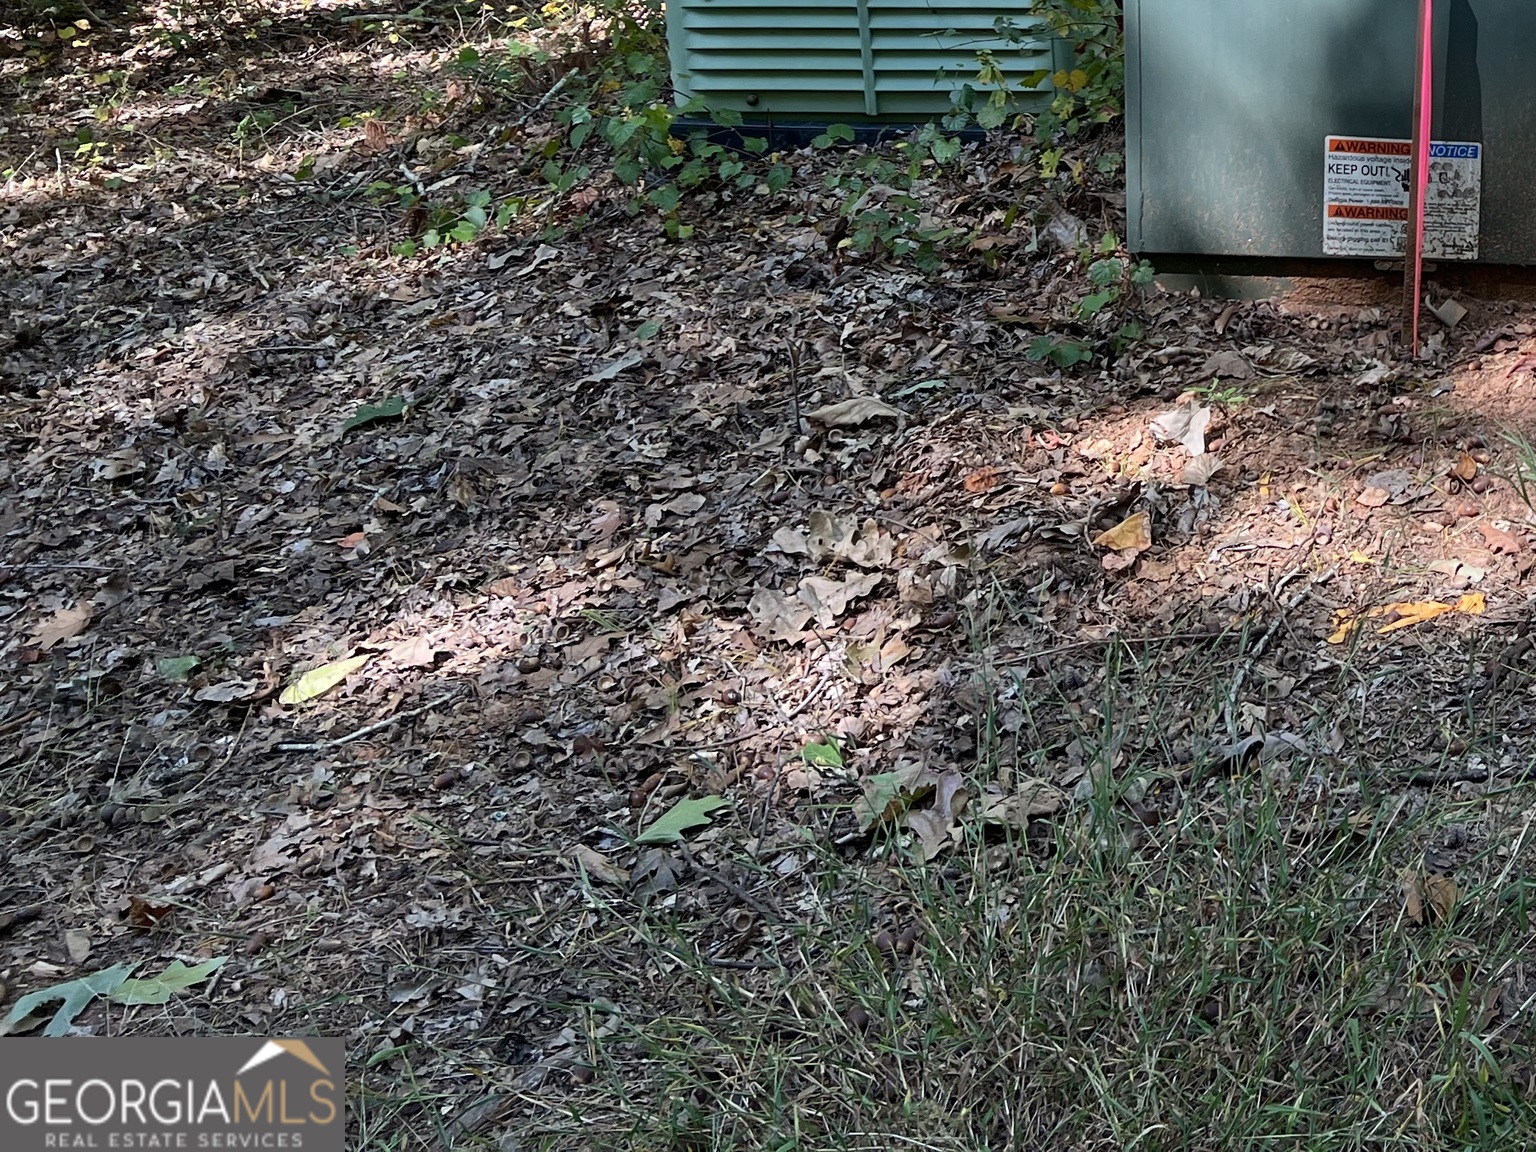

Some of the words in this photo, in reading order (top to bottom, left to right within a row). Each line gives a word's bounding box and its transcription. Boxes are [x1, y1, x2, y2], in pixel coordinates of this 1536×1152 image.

[1346, 141, 1411, 155] WARNING
[1429, 145, 1476, 158] NOTICE
[1328, 154, 1365, 162] Hazardous
[1367, 156, 1391, 164] voltage
[1393, 156, 1411, 164] insid
[1328, 164, 1357, 175] KEEP
[1361, 165, 1391, 177] OUT!
[1345, 206, 1408, 219] WARNING
